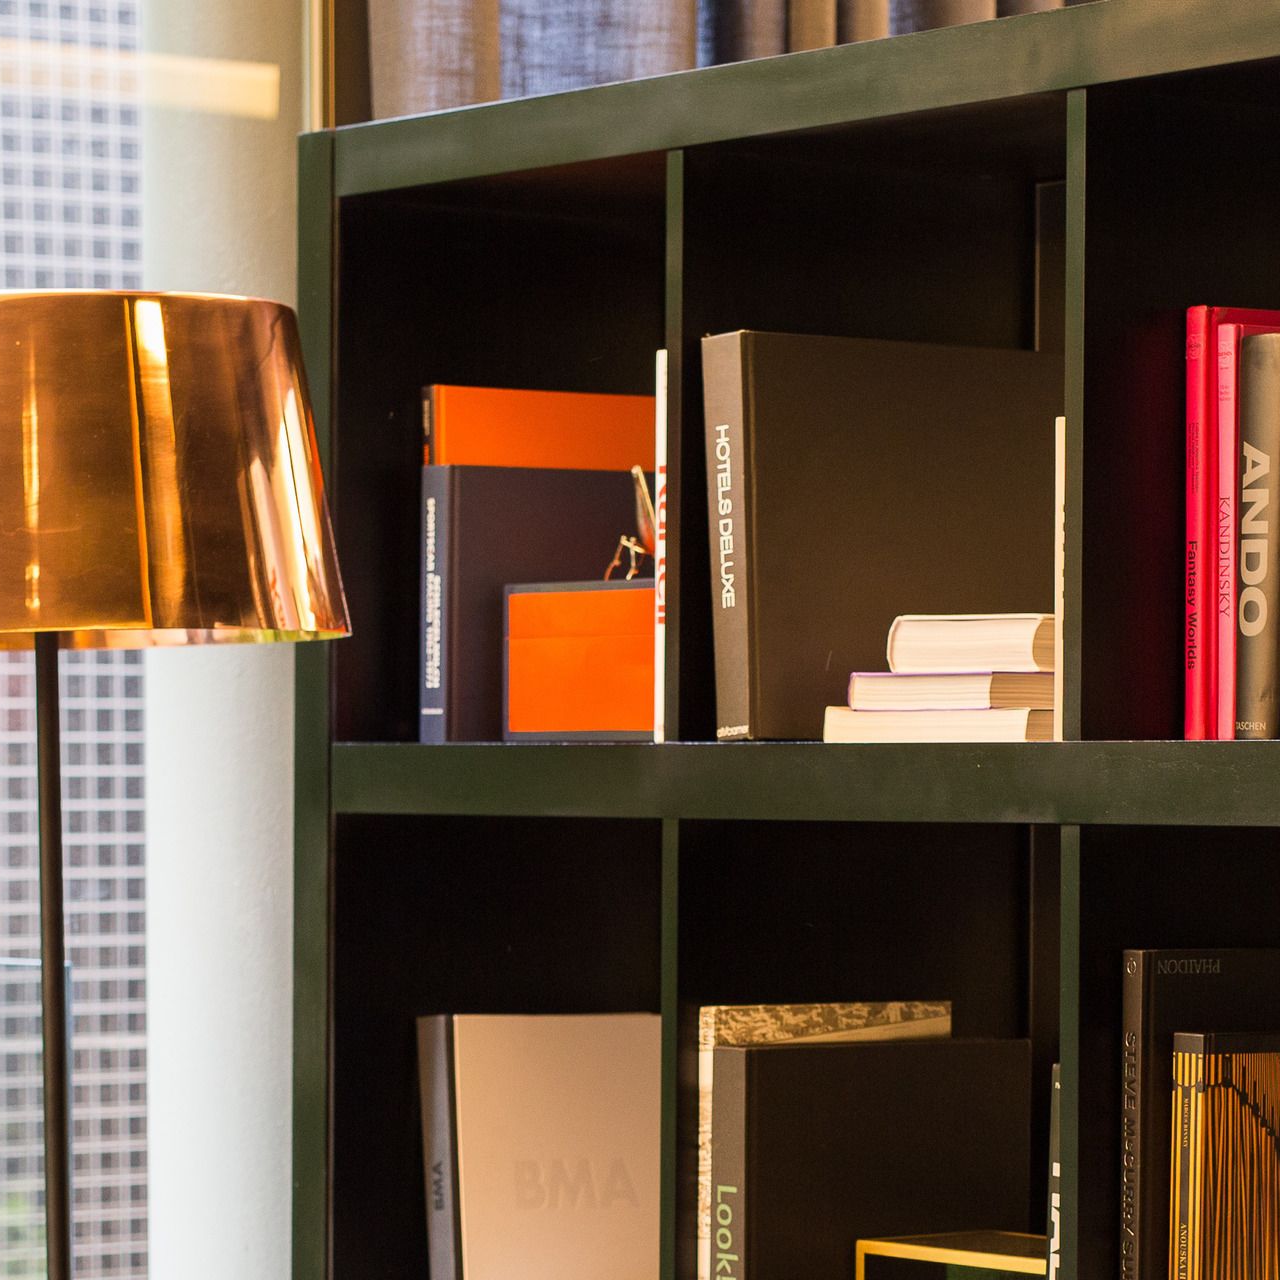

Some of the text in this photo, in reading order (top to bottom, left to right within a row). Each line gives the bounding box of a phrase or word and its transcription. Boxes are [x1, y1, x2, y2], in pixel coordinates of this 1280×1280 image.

[715, 425, 736, 608] HOTELS DELUXE
[1239, 441, 1271, 638] ANDO
[1218, 496, 1232, 618] KANDINSKY
[1186, 540, 1198, 670] Fantasy Worlds
[1235, 721, 1266, 731] TASCHEN
[1158, 959, 1221, 974] PHAIDON
[1125, 1031, 1137, 1110] STEVE
[432, 1161, 444, 1210] BMA
[516, 1158, 637, 1211] BMA
[1123, 1117, 1136, 1236] McCURRY
[1179, 1223, 1187, 1269] ANOUSKA
